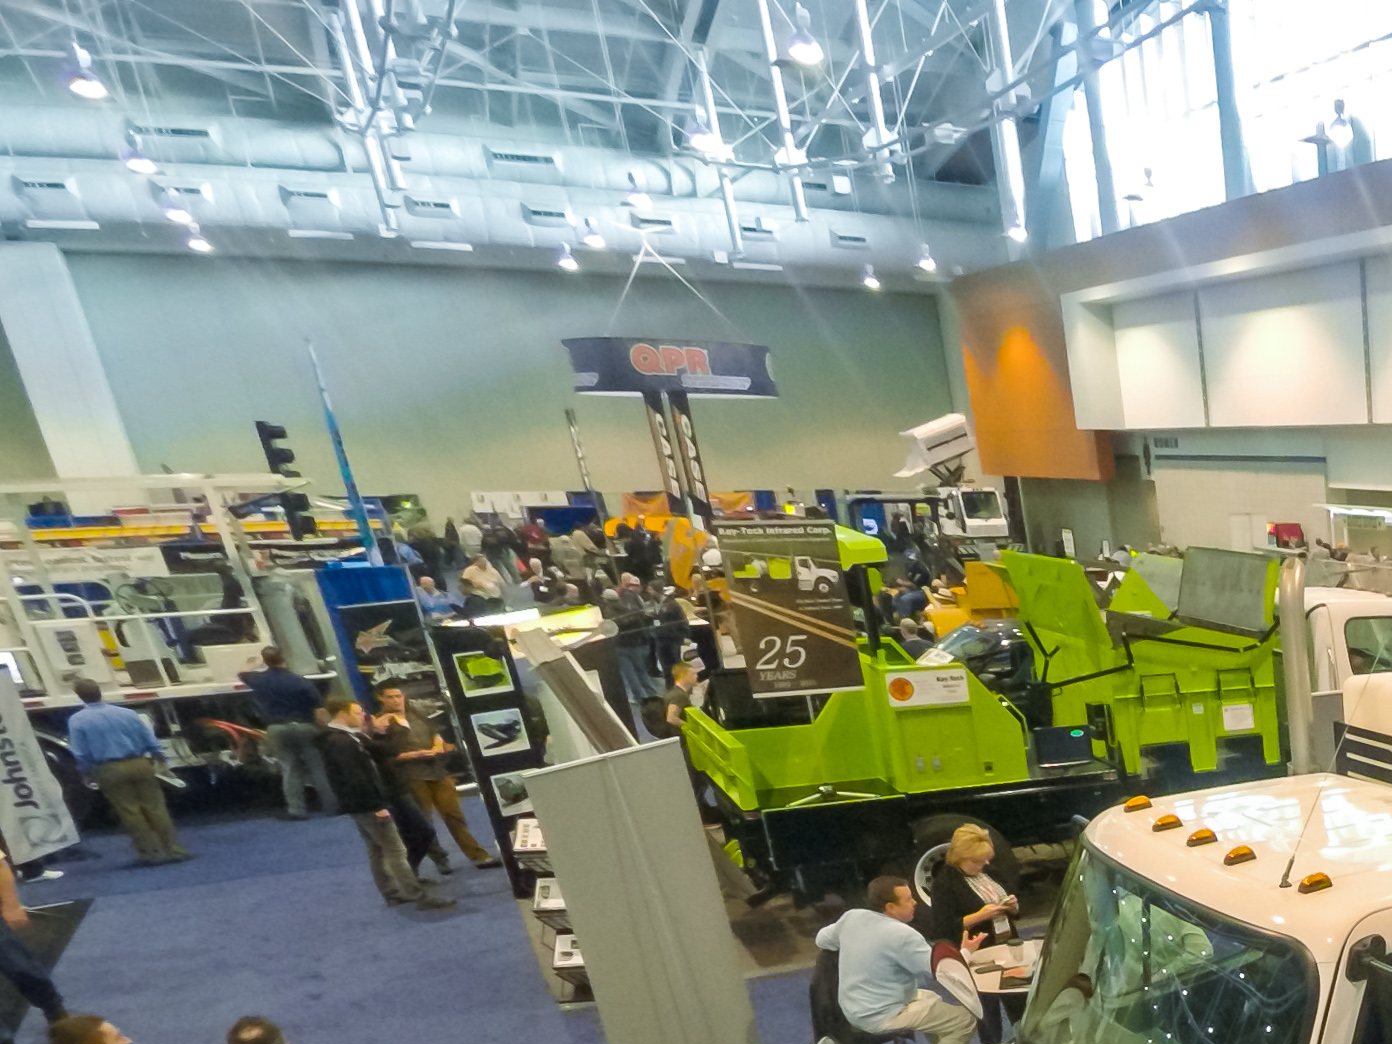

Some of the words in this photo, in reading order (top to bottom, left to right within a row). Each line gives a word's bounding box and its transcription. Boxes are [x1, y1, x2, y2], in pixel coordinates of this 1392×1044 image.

[630, 343, 712, 376] QPR
[655, 412, 681, 499] CASE
[681, 414, 708, 503] CASE
[755, 634, 808, 671] 25
[760, 670, 797, 681] YEARS
